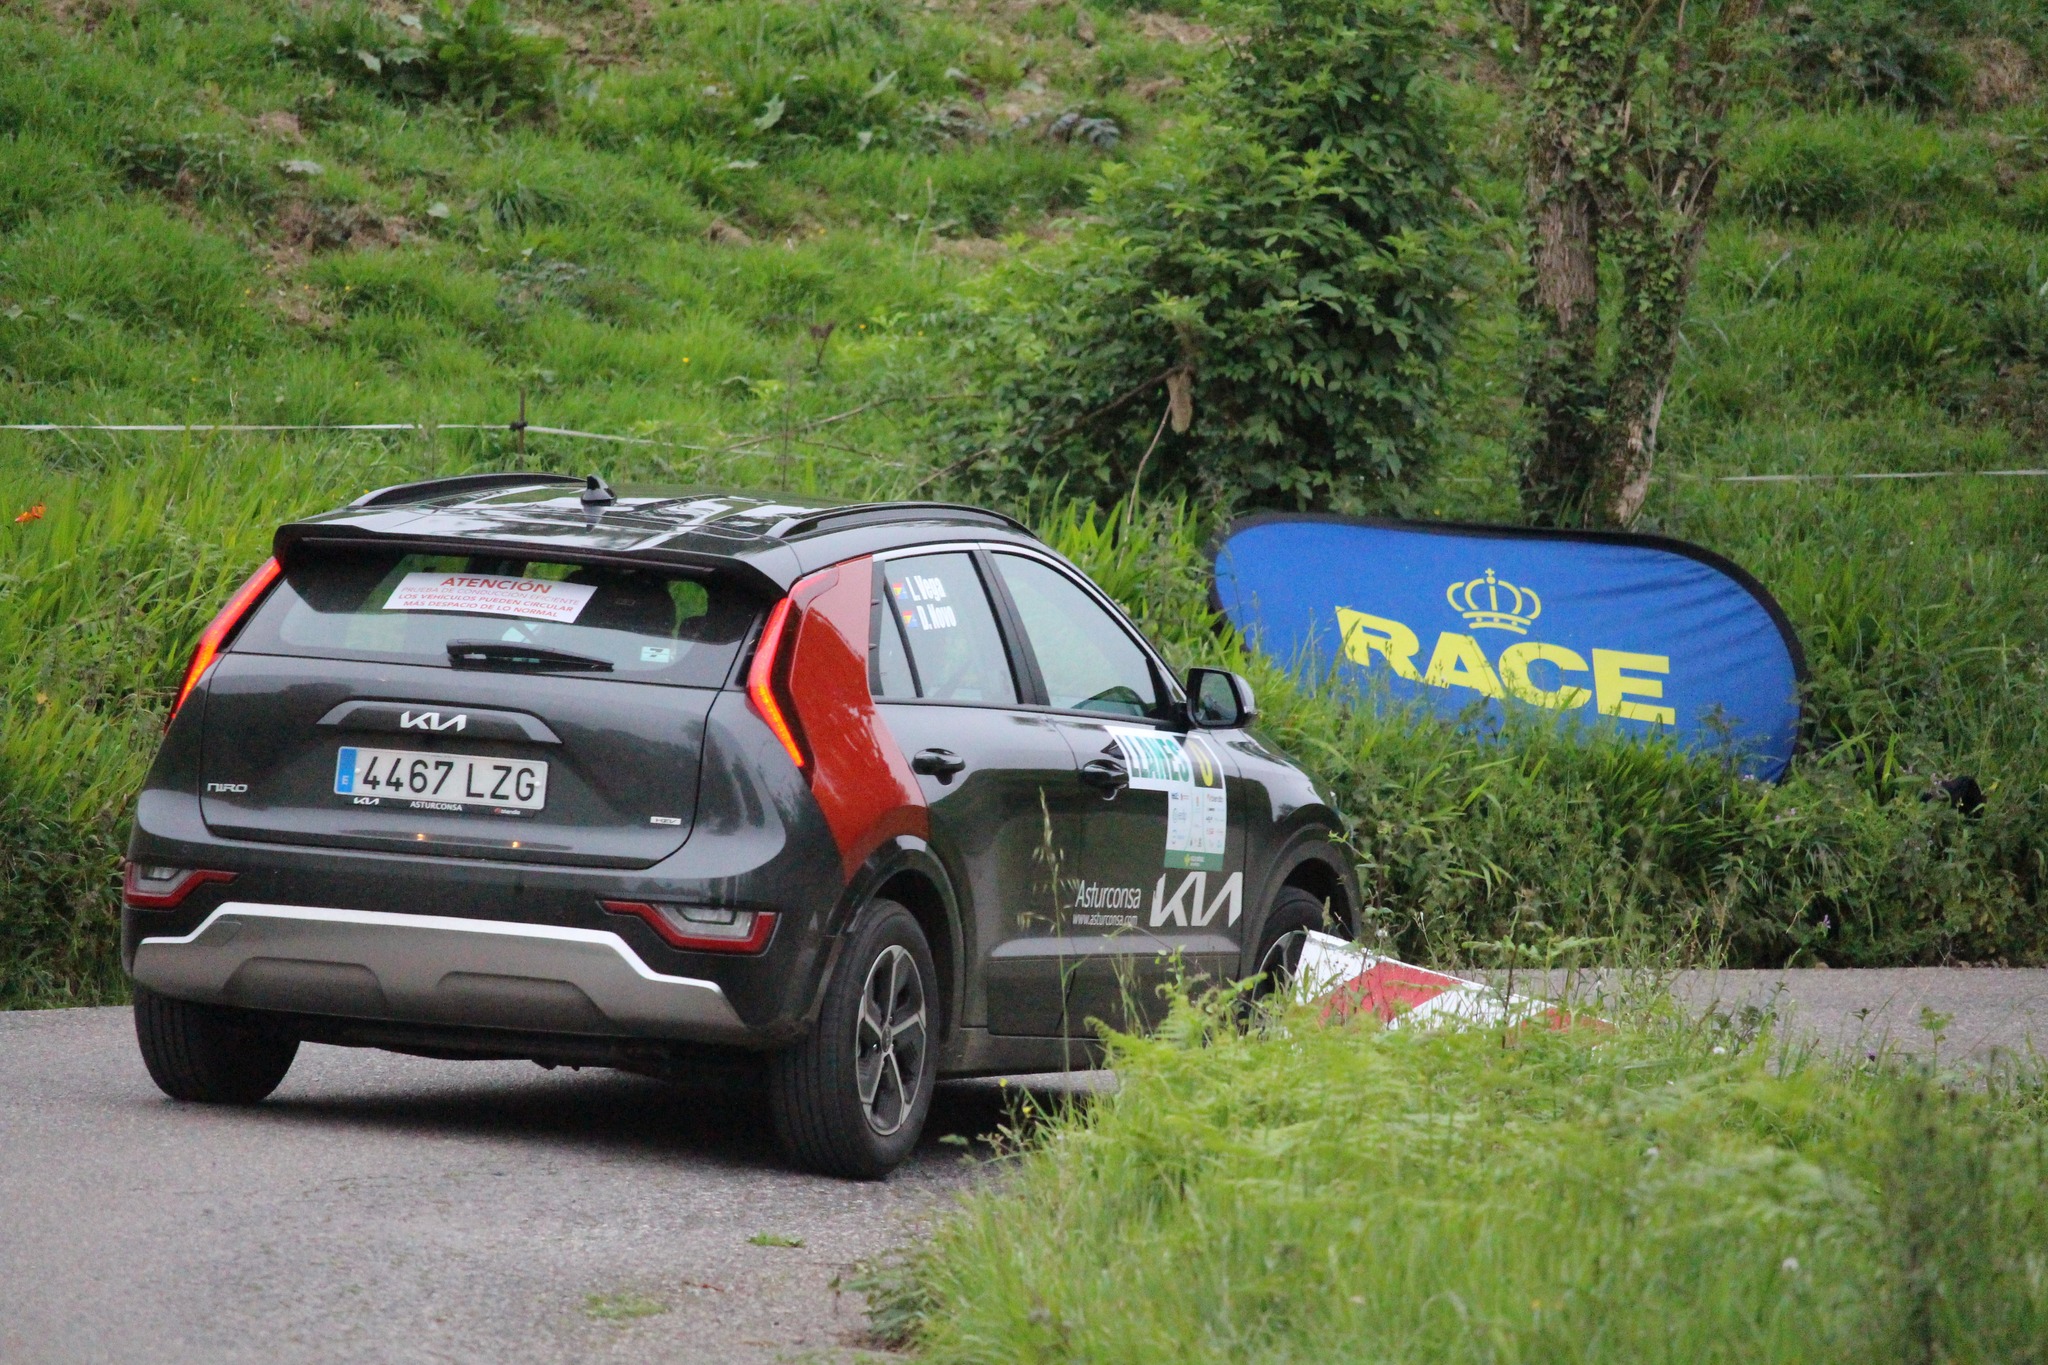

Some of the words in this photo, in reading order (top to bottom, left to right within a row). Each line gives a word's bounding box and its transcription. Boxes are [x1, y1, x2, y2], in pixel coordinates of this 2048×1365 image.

[441, 577, 553, 594] ATENCIÓN
[401, 586, 439, 594] PRUEBA
[457, 588, 529, 599] CONDUCCIÓN
[529, 593, 580, 606] EFICIENTE
[479, 596, 521, 606] PUEDEN
[523, 600, 574, 613] CIRCULAR
[429, 600, 478, 609] DESPACIO
[513, 607, 558, 618] NORMAL
[1335, 605, 1676, 725] RACE
[400, 710, 467, 732] KIA
[342, 774, 350, 785] E
[362, 756, 454, 796] 4467
[466, 763, 536, 801] LZG
[353, 797, 380, 806] KIA
[409, 801, 463, 812] ASTURCONSA
[1074, 880, 1142, 909] Asturconsa
[1149, 871, 1243, 928] KIA
